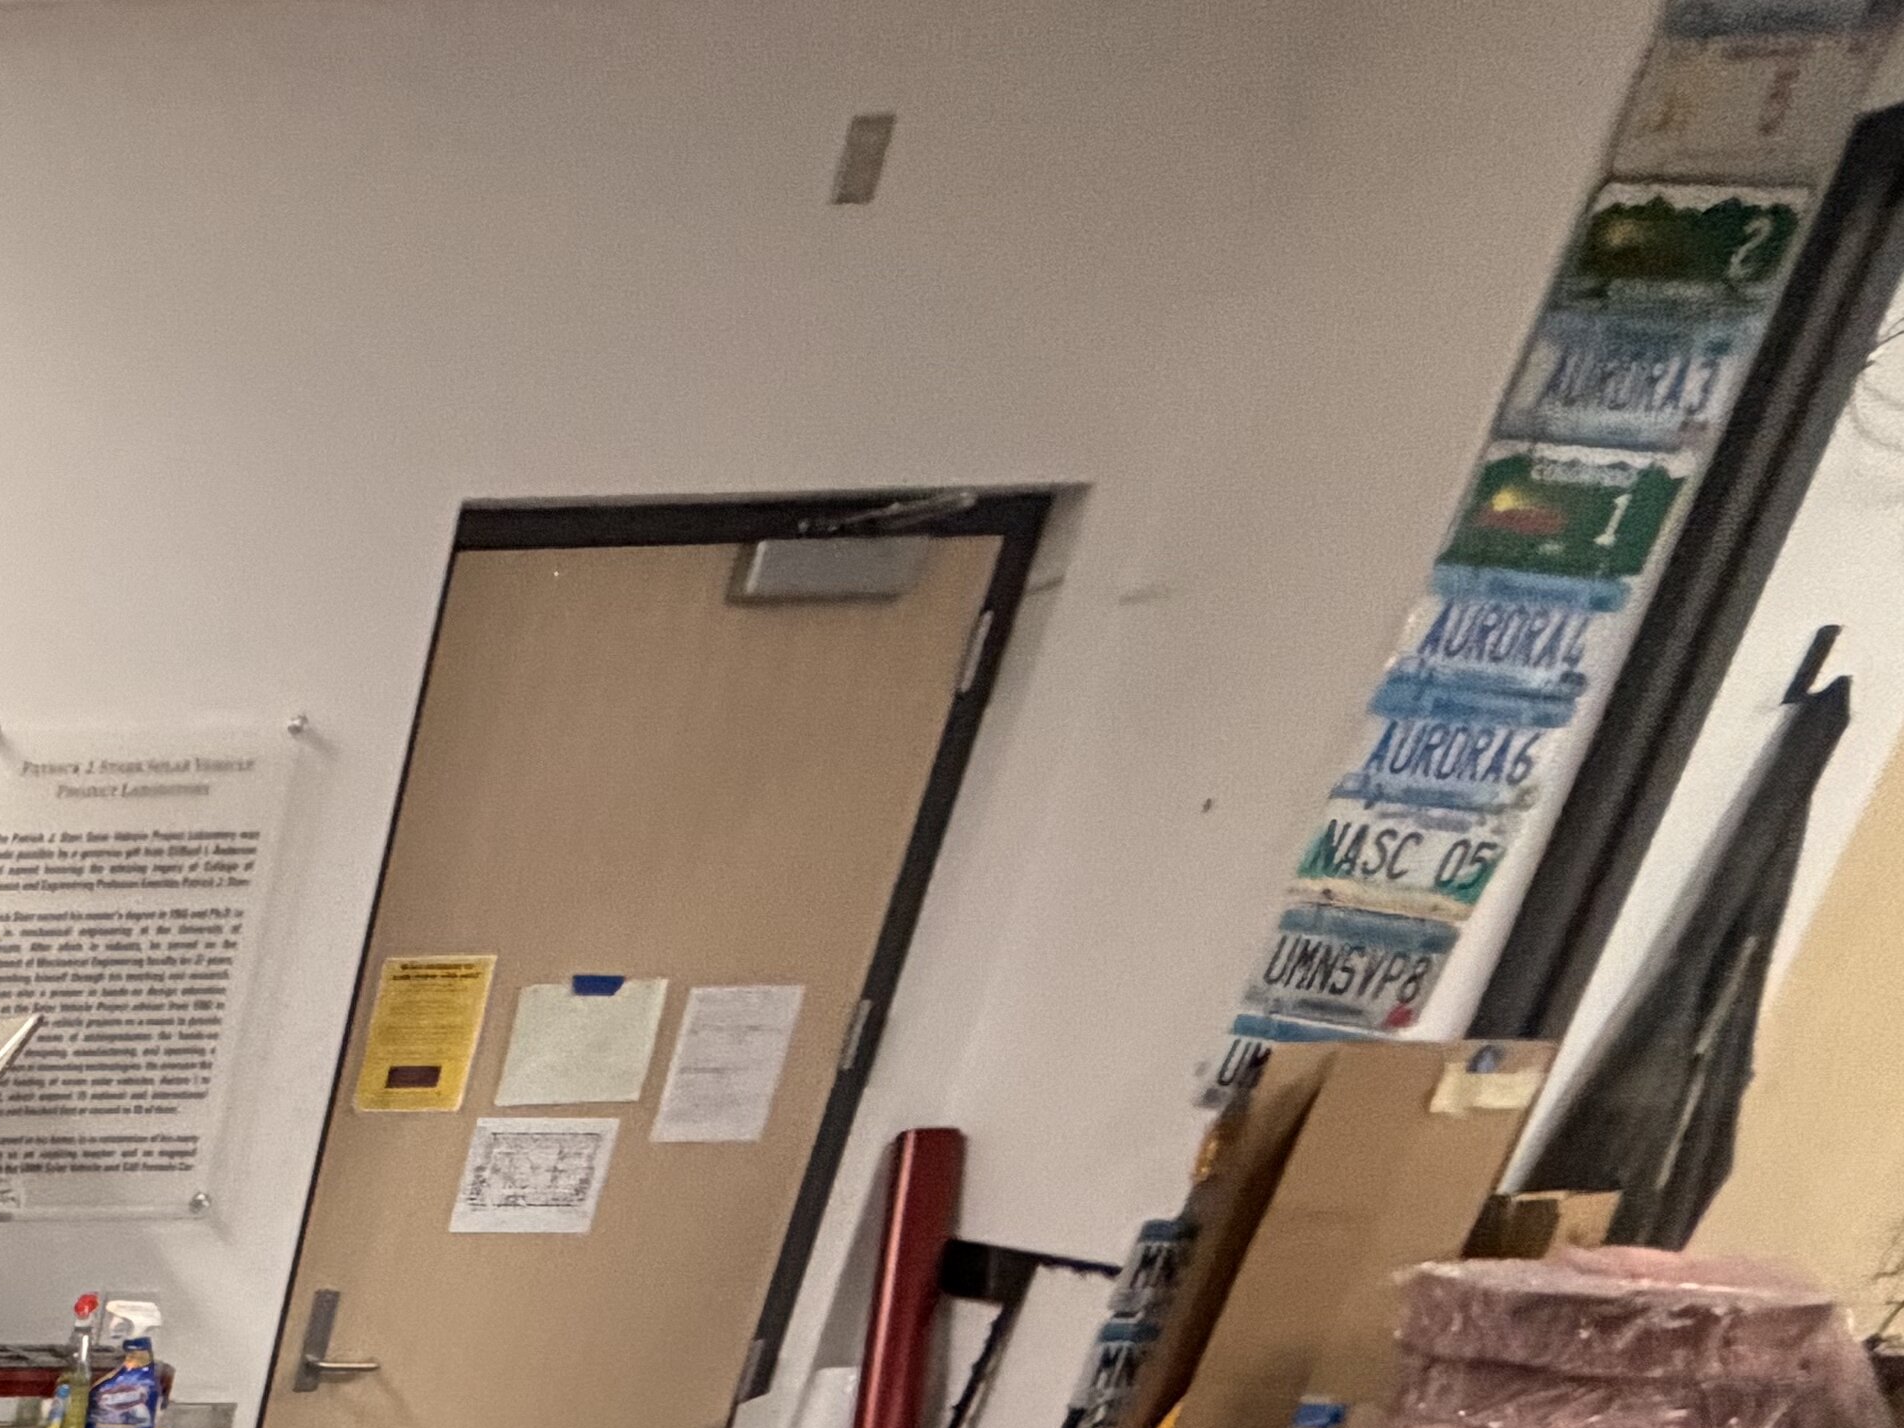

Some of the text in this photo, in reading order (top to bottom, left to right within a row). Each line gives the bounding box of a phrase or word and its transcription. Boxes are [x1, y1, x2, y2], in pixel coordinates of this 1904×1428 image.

[1365, 719, 1542, 785] AURORA6
[1310, 818, 1499, 890] NASC 05
